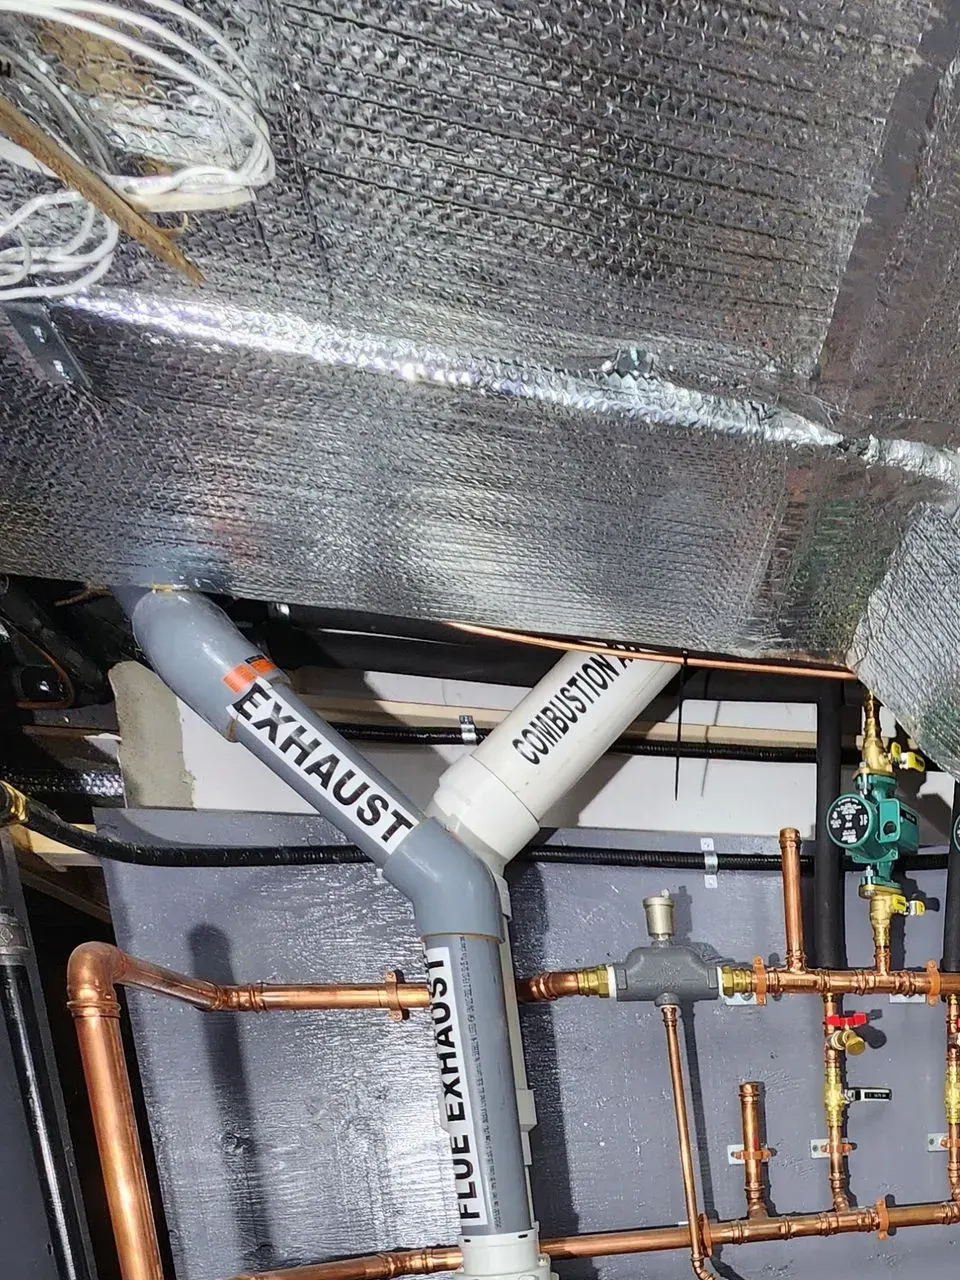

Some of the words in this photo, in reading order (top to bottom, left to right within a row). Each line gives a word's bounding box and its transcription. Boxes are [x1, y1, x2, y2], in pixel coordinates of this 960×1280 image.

[232, 683, 414, 843] EXHAUST
[512, 653, 620, 765] COMBUSTION
[426, 959, 466, 1122] EXHAUST
[451, 1134, 480, 1220] FLUE
